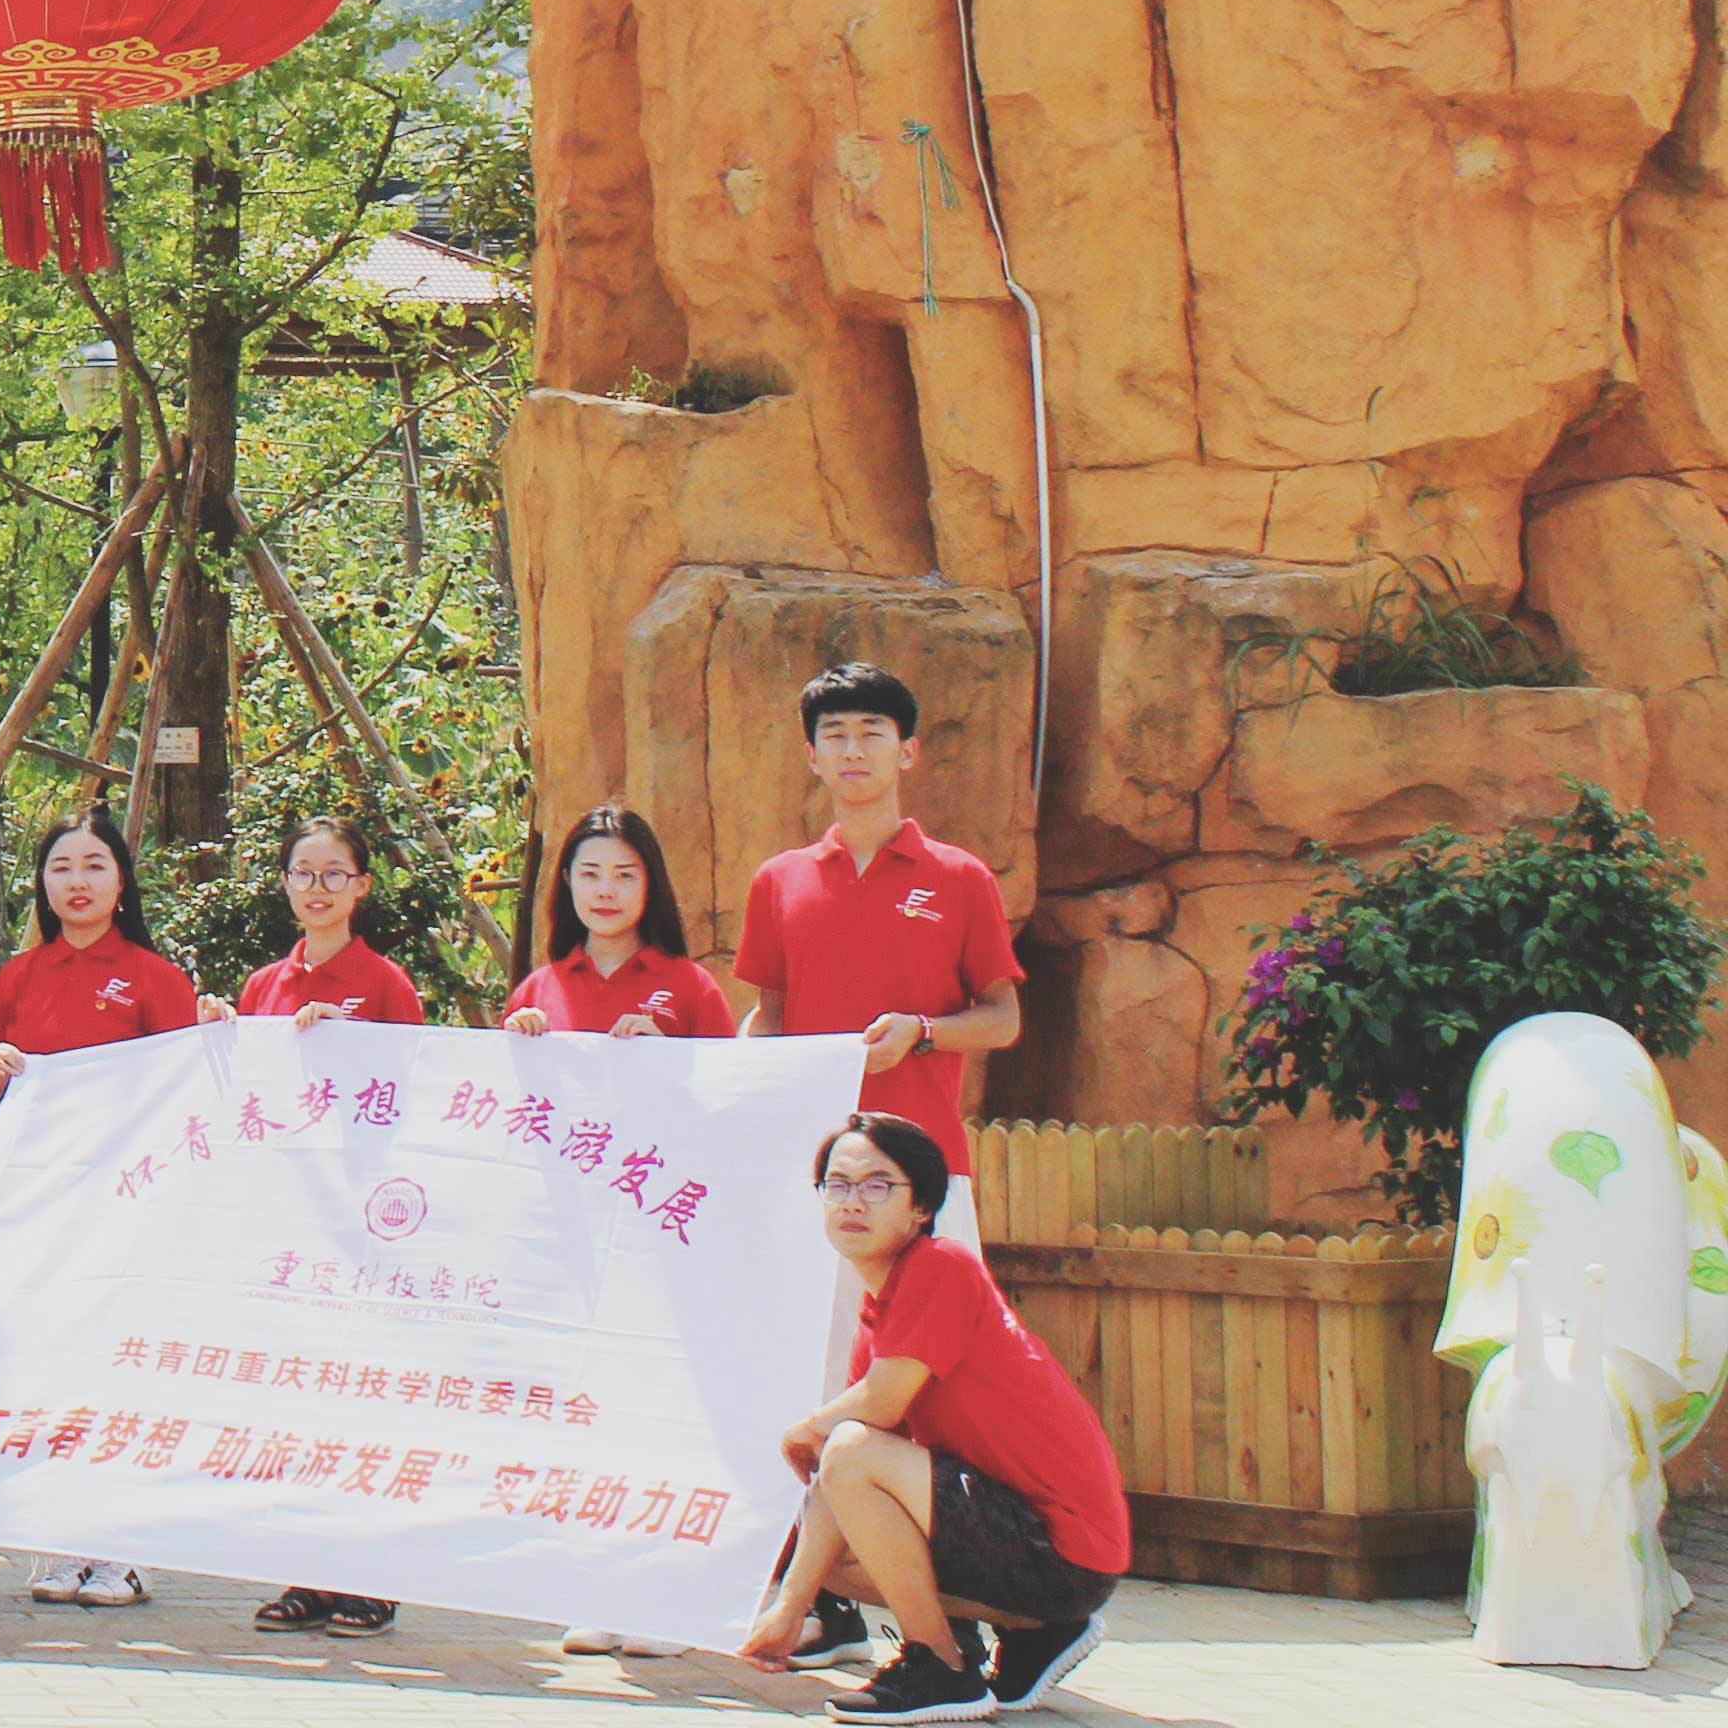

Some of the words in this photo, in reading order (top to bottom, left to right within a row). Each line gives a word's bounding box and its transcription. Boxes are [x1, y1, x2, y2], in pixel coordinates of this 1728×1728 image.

[115, 1077, 401, 1200] 怀青春梦想
[440, 1079, 708, 1246] 助旅游发展
[113, 1335, 601, 1427] 共青团重庆科技学院委员会
[482, 1460, 733, 1547] 实践助力团
